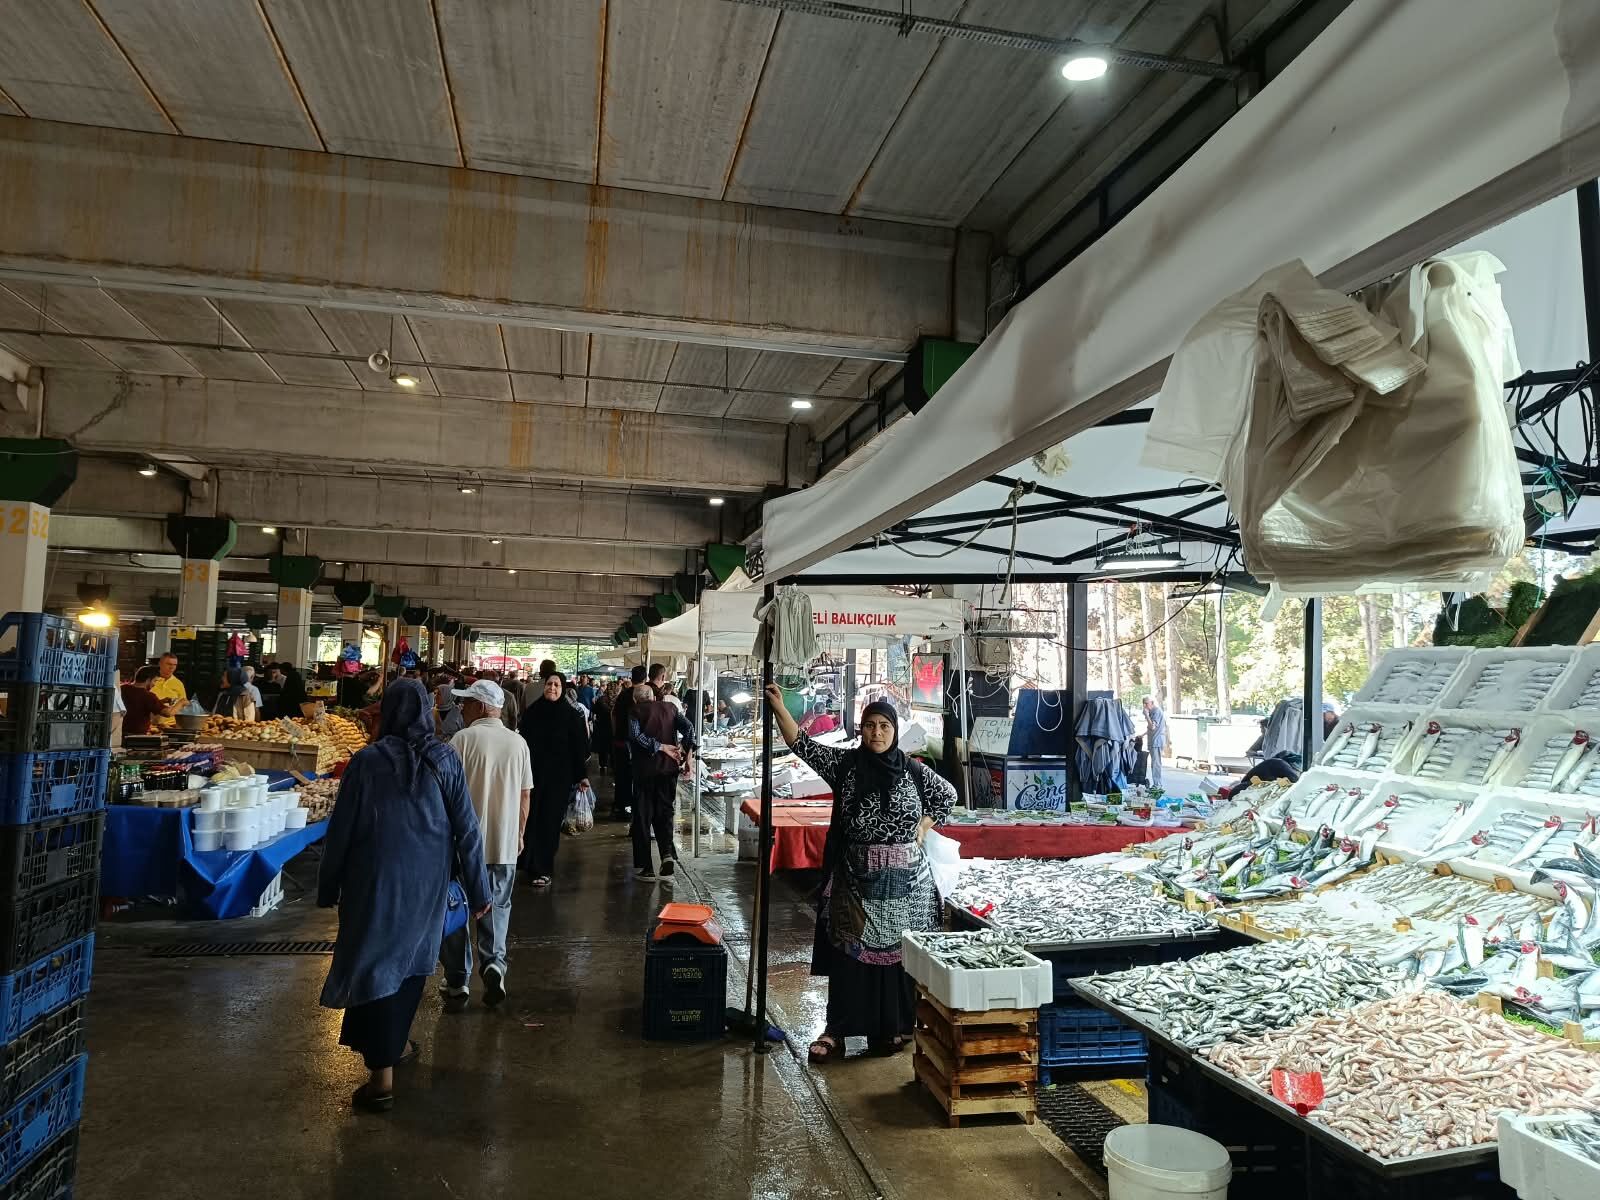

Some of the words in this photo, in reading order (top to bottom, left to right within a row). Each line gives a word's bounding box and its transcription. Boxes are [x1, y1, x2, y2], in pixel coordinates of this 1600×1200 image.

[0, 508, 26, 534] 2
[32, 511, 49, 539] 52
[185, 563, 208, 582] 53
[832, 612, 896, 628] BALIKÇILIK
